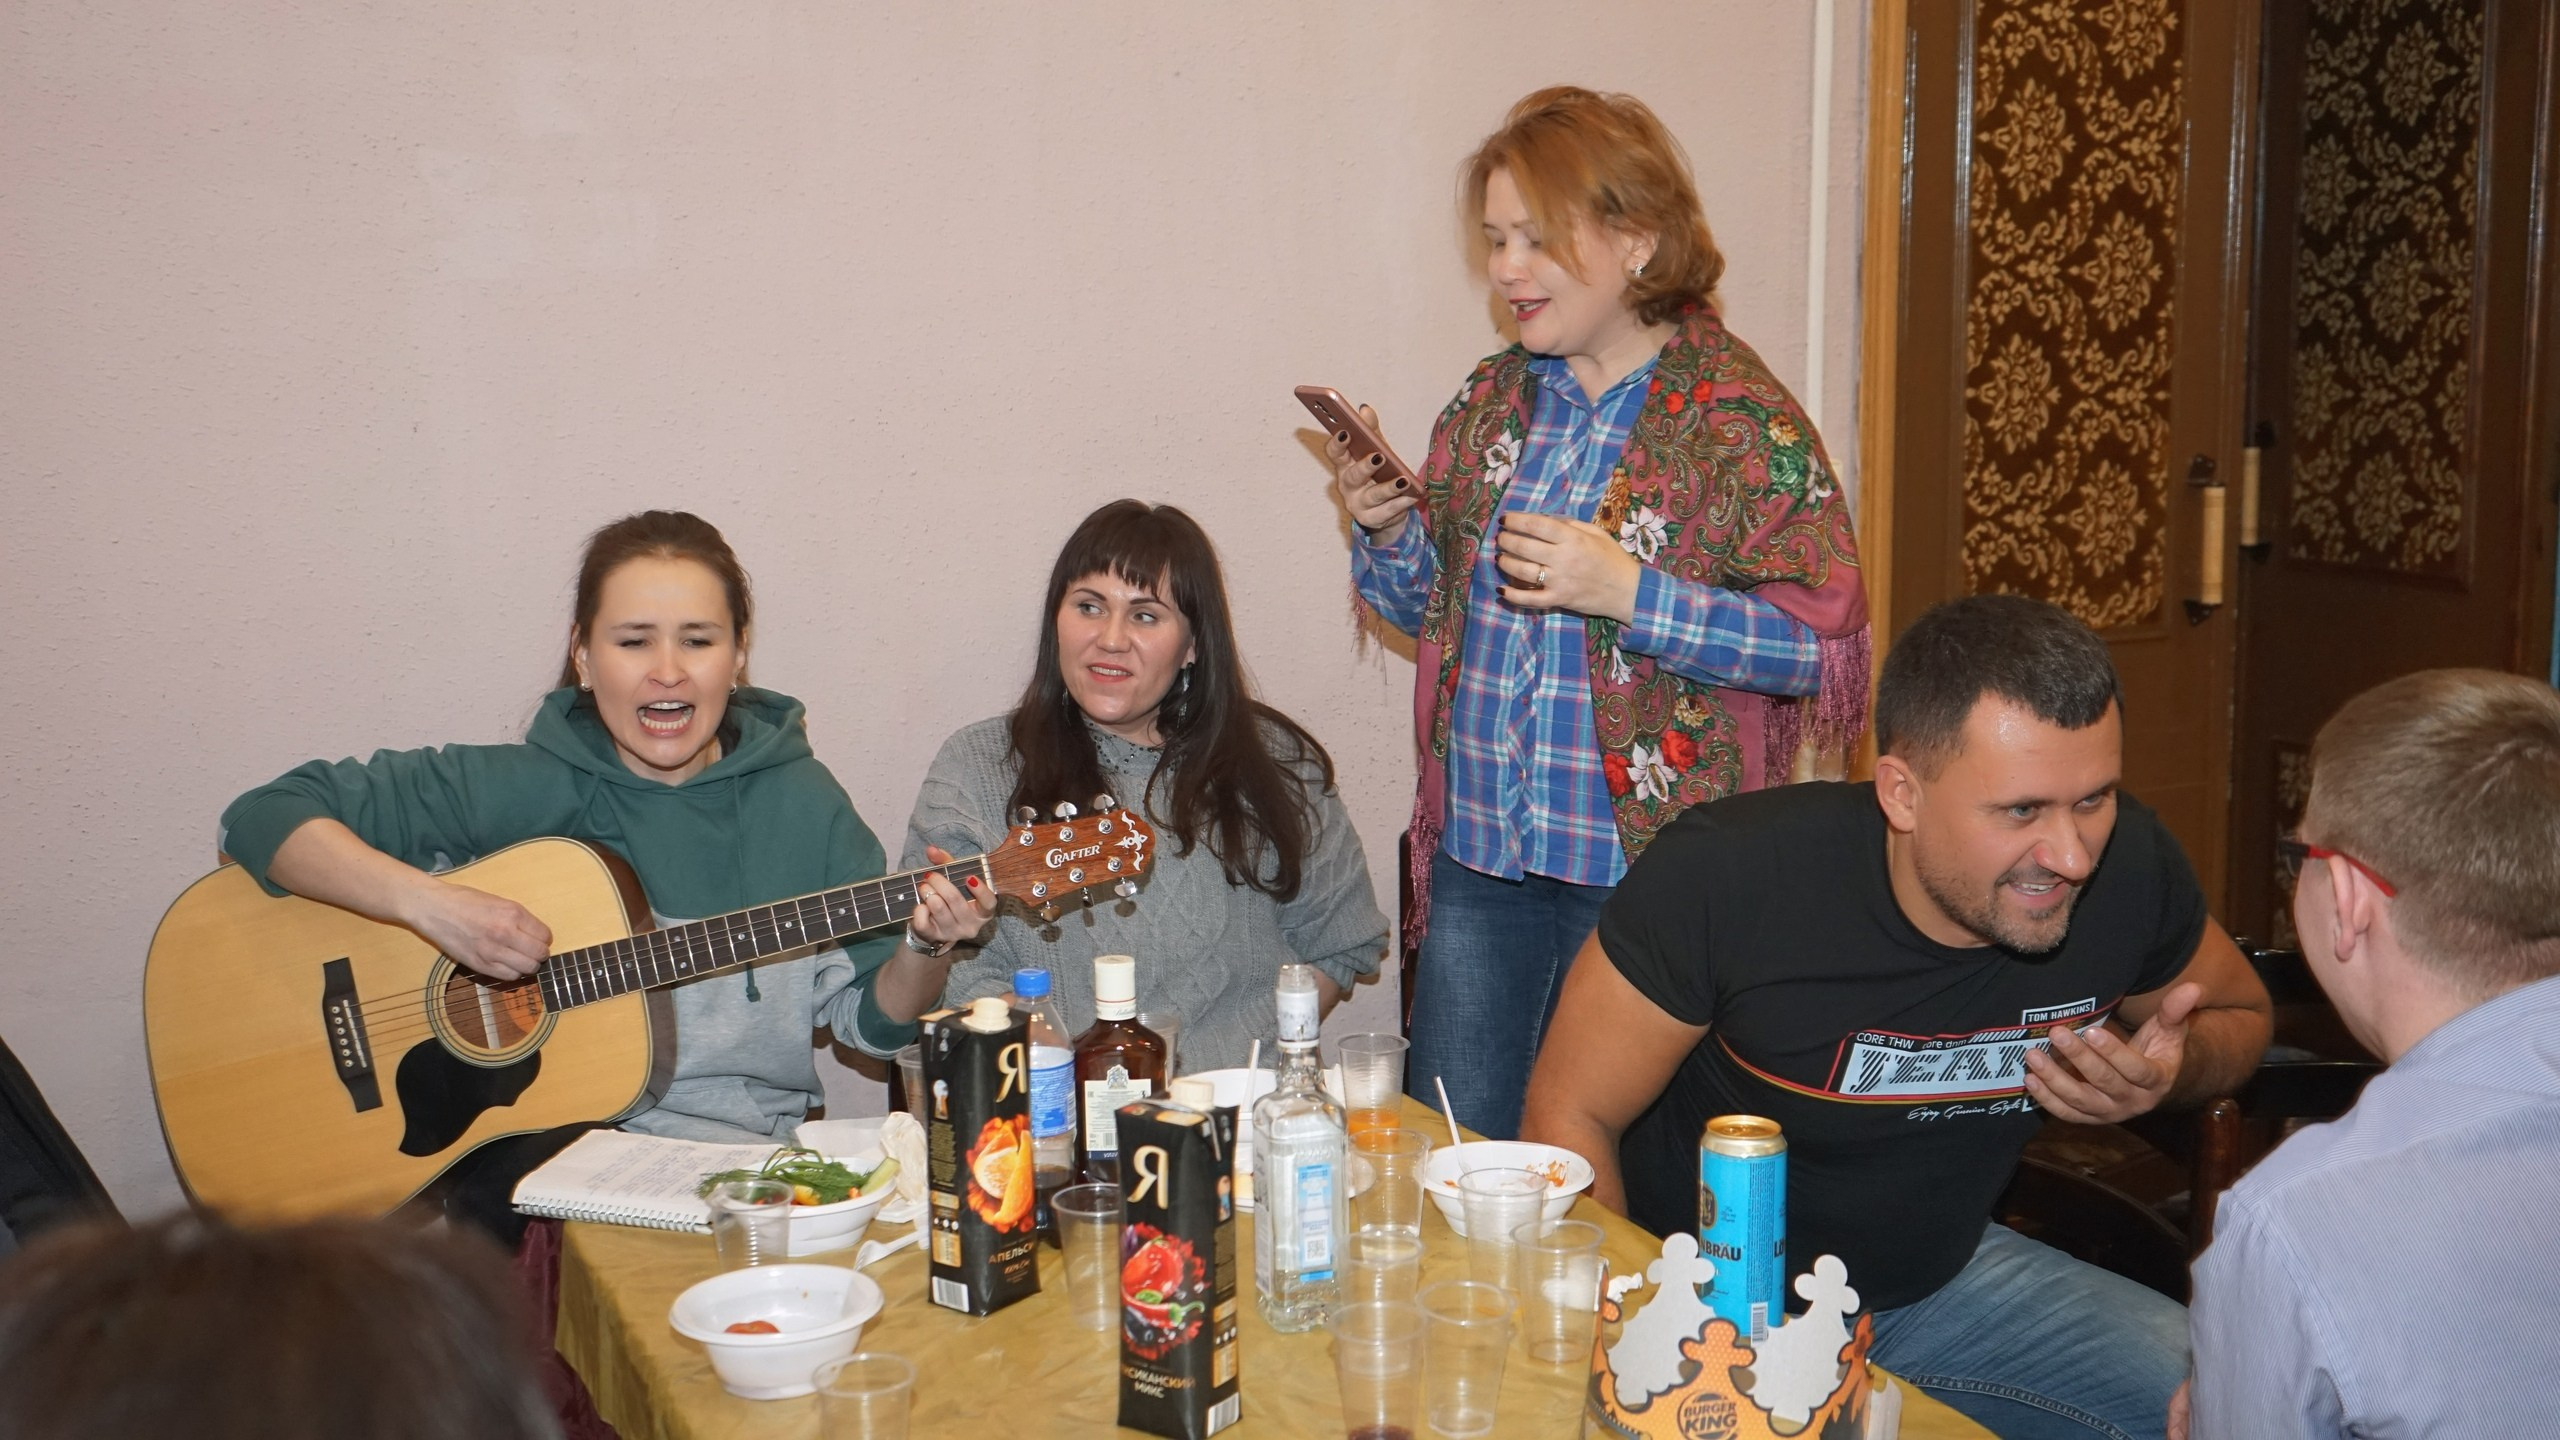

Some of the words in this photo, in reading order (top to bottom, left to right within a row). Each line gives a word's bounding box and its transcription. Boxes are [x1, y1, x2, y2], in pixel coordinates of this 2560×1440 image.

[1046, 842, 1101, 869] CRAFTER
[2028, 1013, 2048, 1022] TOM
[2051, 1003, 2091, 1020] HAWKINS
[1856, 1032, 1885, 1045] CORE
[1889, 1036, 1915, 1050] THW
[1922, 1039, 1943, 1050] core
[998, 1042, 1027, 1103] Я
[1849, 1036, 2052, 1094] JEAN
[1907, 1106, 1940, 1121] Enjoy
[1988, 1098, 2022, 1116] Style
[1127, 1145, 1169, 1210] Я
[1134, 1381, 1165, 1399] МИКС
[1684, 1402, 1737, 1418] BURGER
[1684, 1413, 1738, 1433] KING
